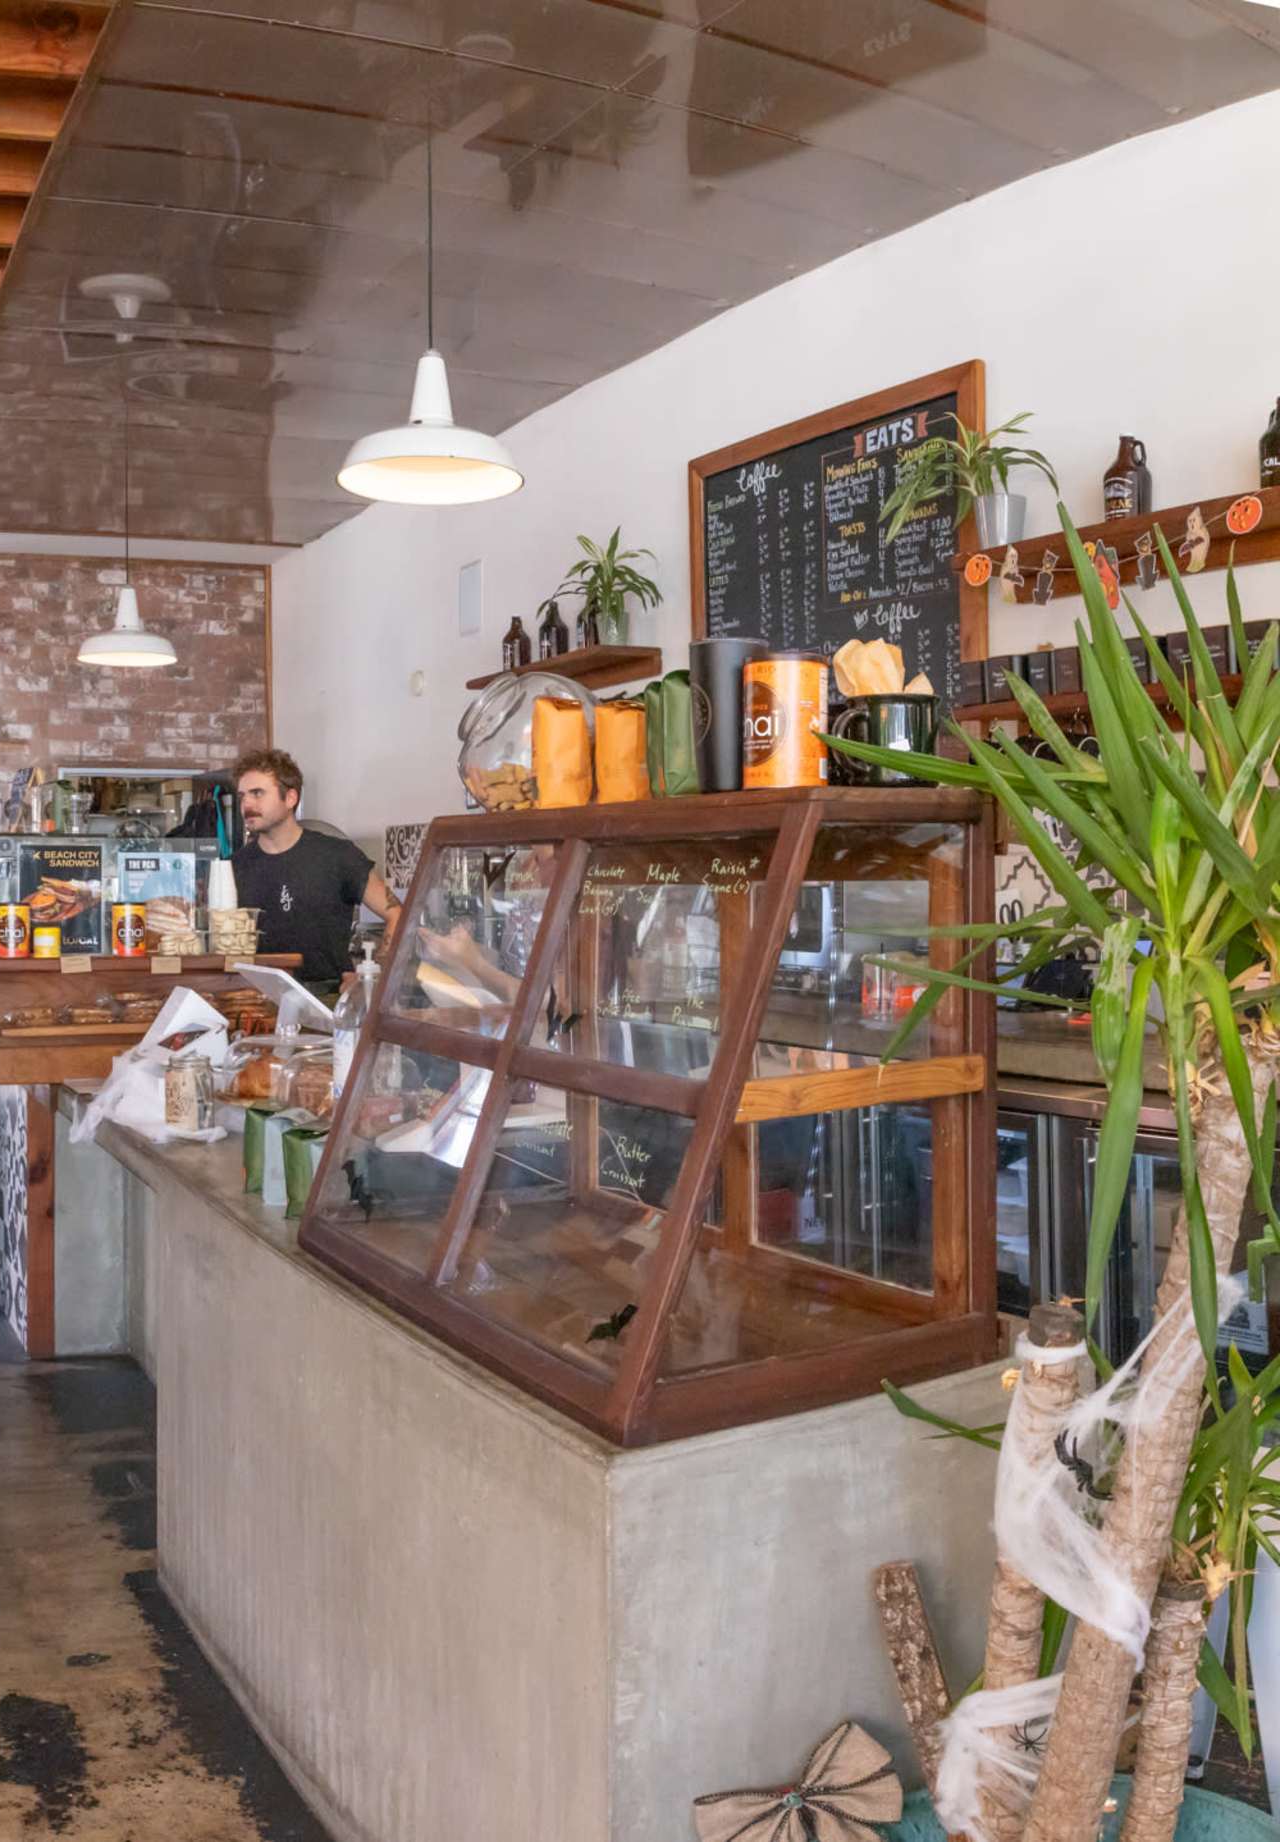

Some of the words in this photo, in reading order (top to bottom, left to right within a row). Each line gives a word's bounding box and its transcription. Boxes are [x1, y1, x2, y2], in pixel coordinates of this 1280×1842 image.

[866, 417, 914, 452] EATS
[736, 461, 782, 496] Coffee
[871, 602, 921, 634] Coffee
[43, 850, 77, 860] BEACH
[78, 850, 100, 860] CITY
[48, 859, 100, 868] SANDWICH
[646, 863, 681, 883] Maple
[118, 927, 145, 938] chai
[617, 1135, 653, 1162] Butter
